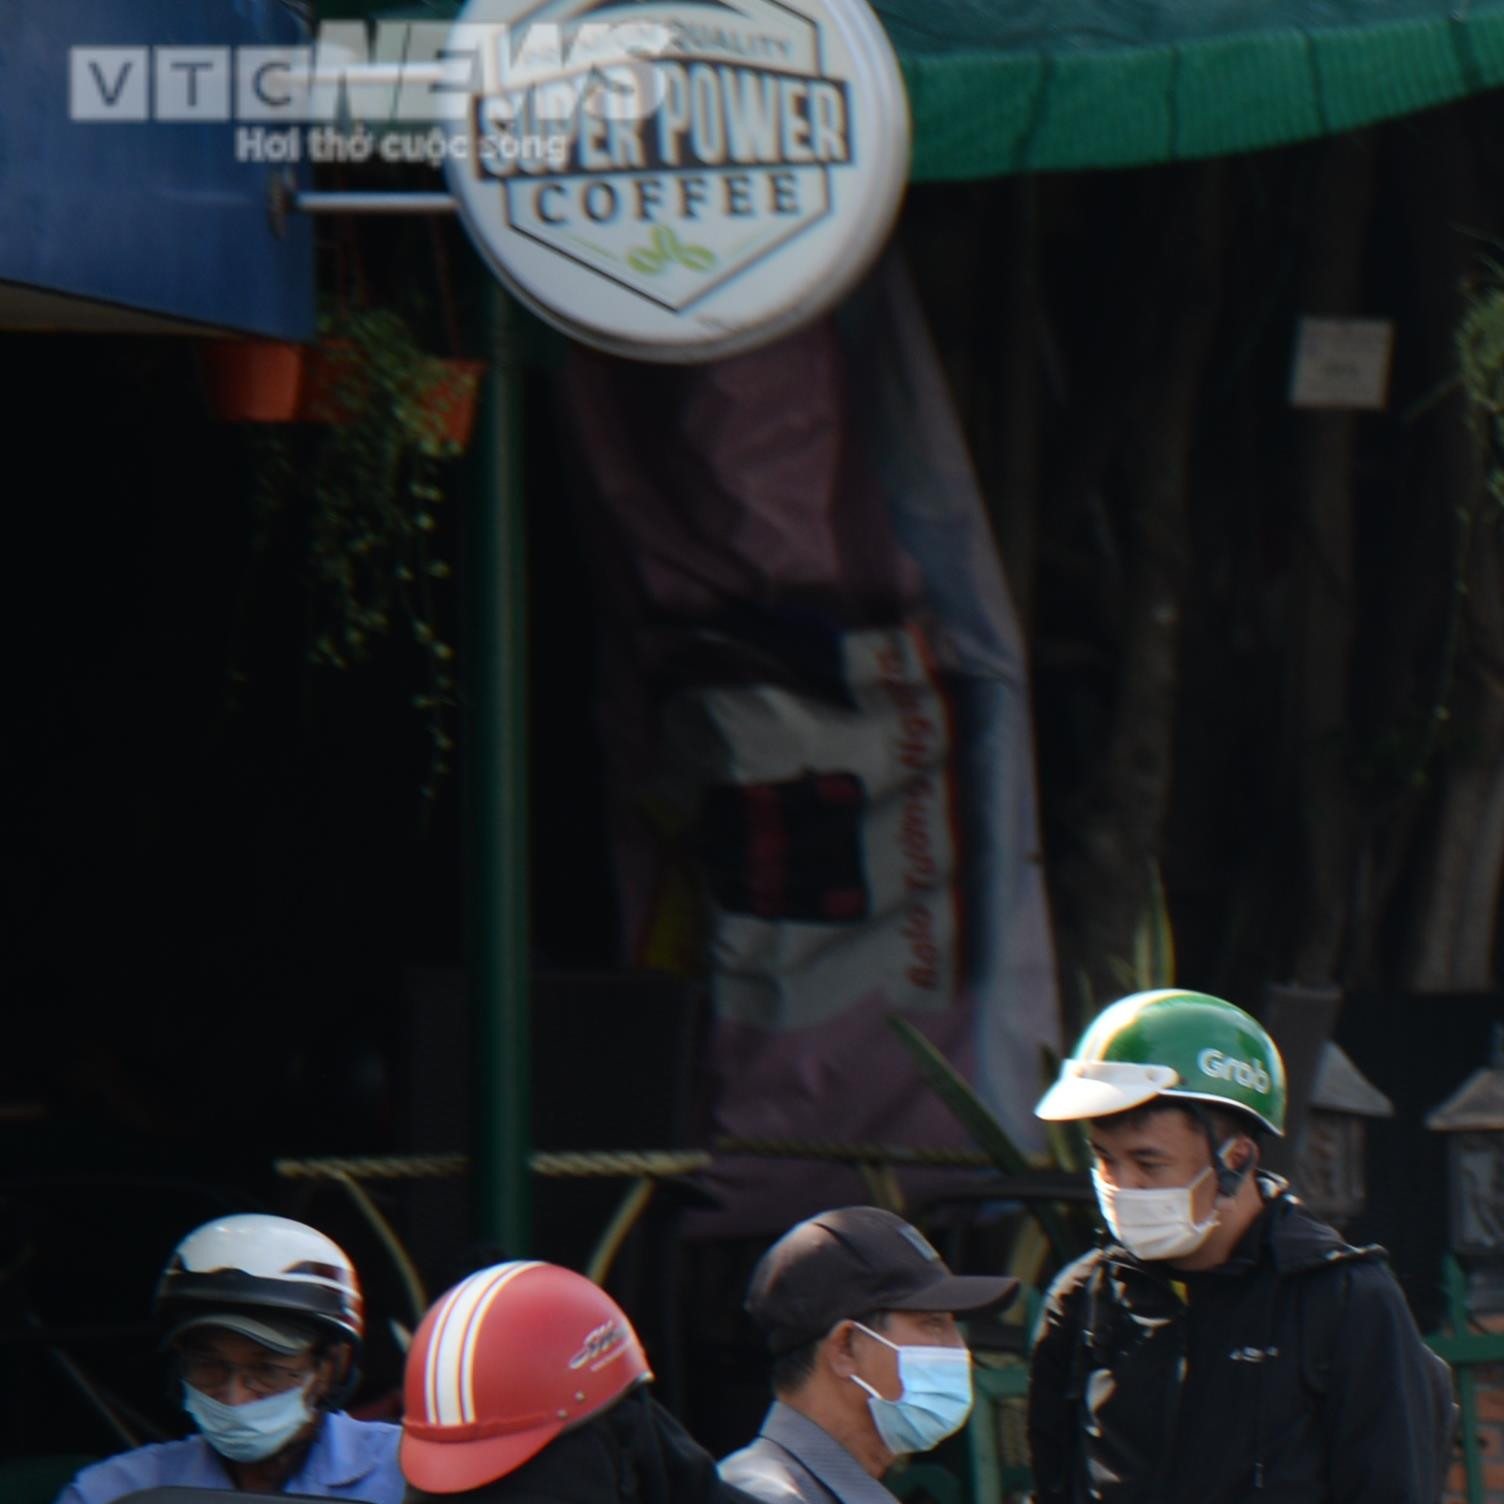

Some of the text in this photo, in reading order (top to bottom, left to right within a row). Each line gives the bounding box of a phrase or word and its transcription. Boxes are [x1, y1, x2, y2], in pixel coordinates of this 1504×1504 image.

[657, 60, 851, 168] POWER
[533, 174, 803, 228] COFFEE
[1197, 1047, 1270, 1095] Grab
